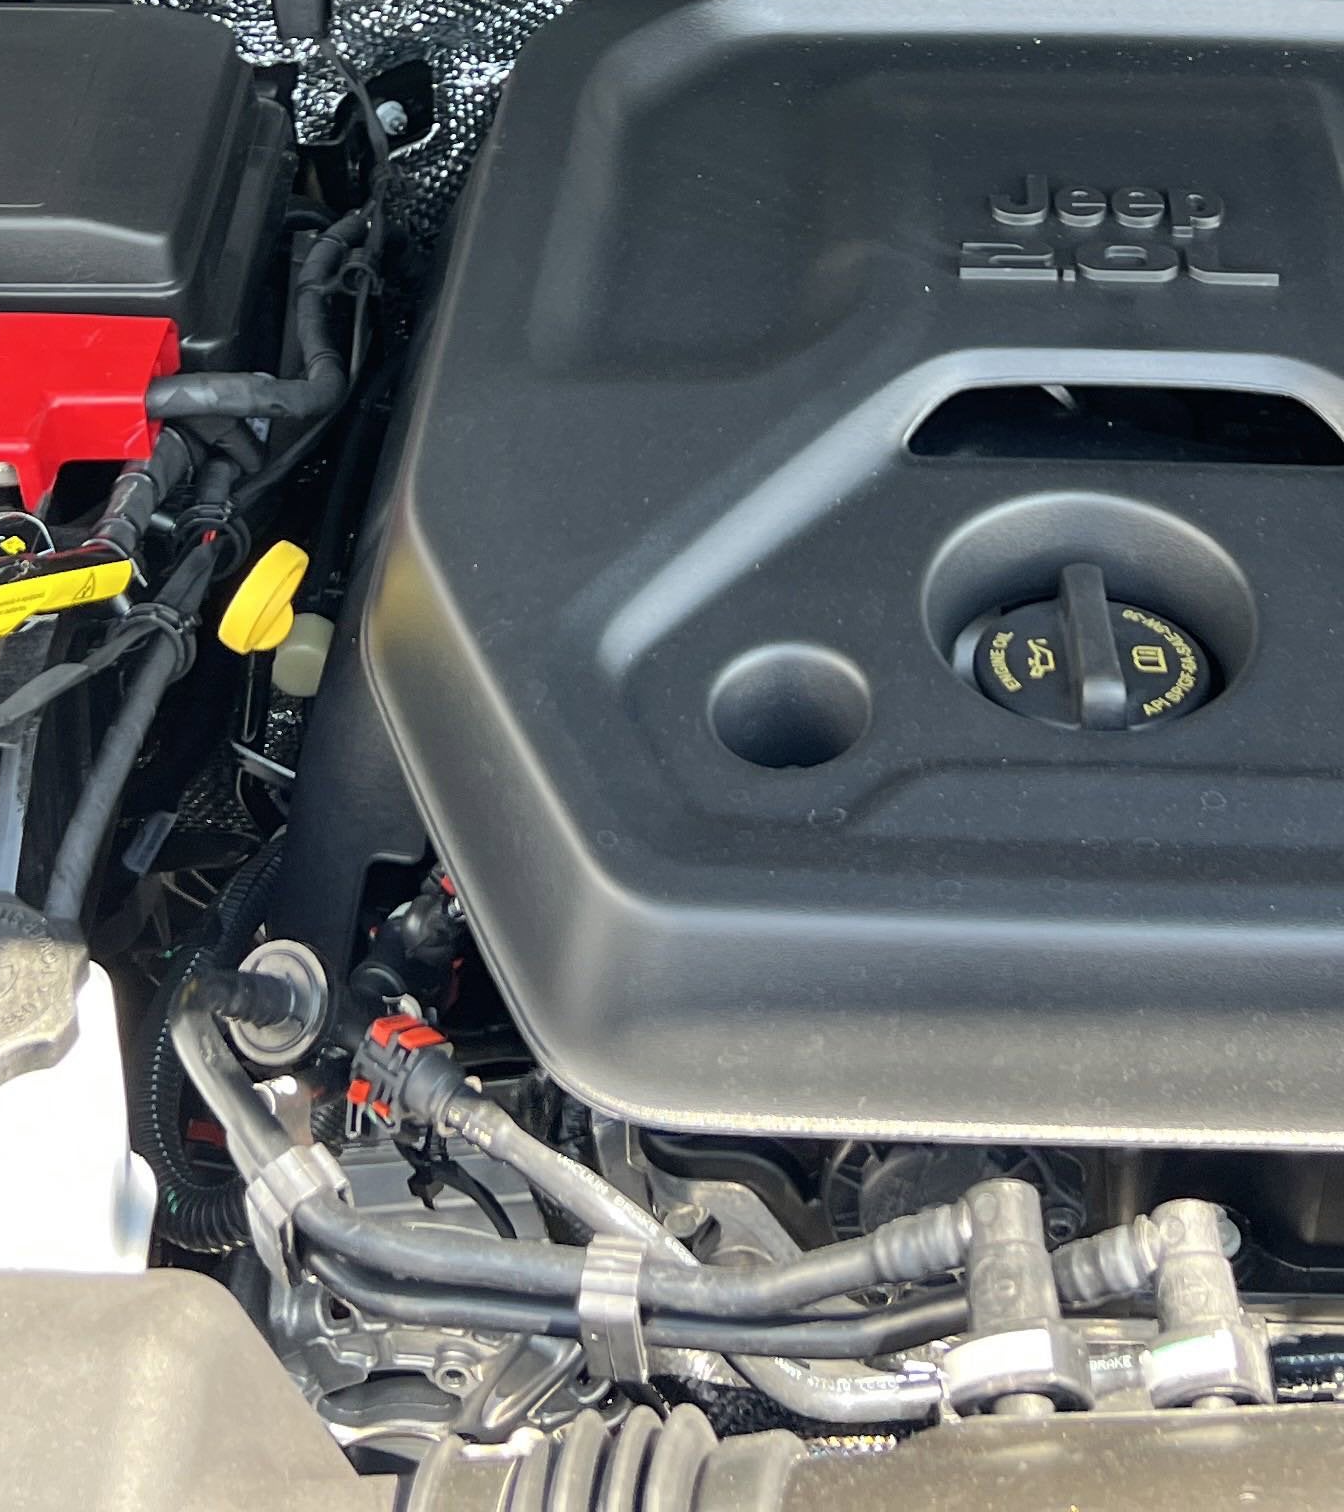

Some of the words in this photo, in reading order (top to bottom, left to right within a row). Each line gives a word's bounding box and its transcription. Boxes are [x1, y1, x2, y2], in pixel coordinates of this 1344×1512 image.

[989, 173, 1225, 238] Jeep
[959, 241, 1280, 287] 2.0L
[992, 631, 1014, 650] OIL
[989, 649, 1023, 693] ENGINE
[1142, 696, 1171, 718] API
[1089, 1354, 1133, 1371] BRAKE
